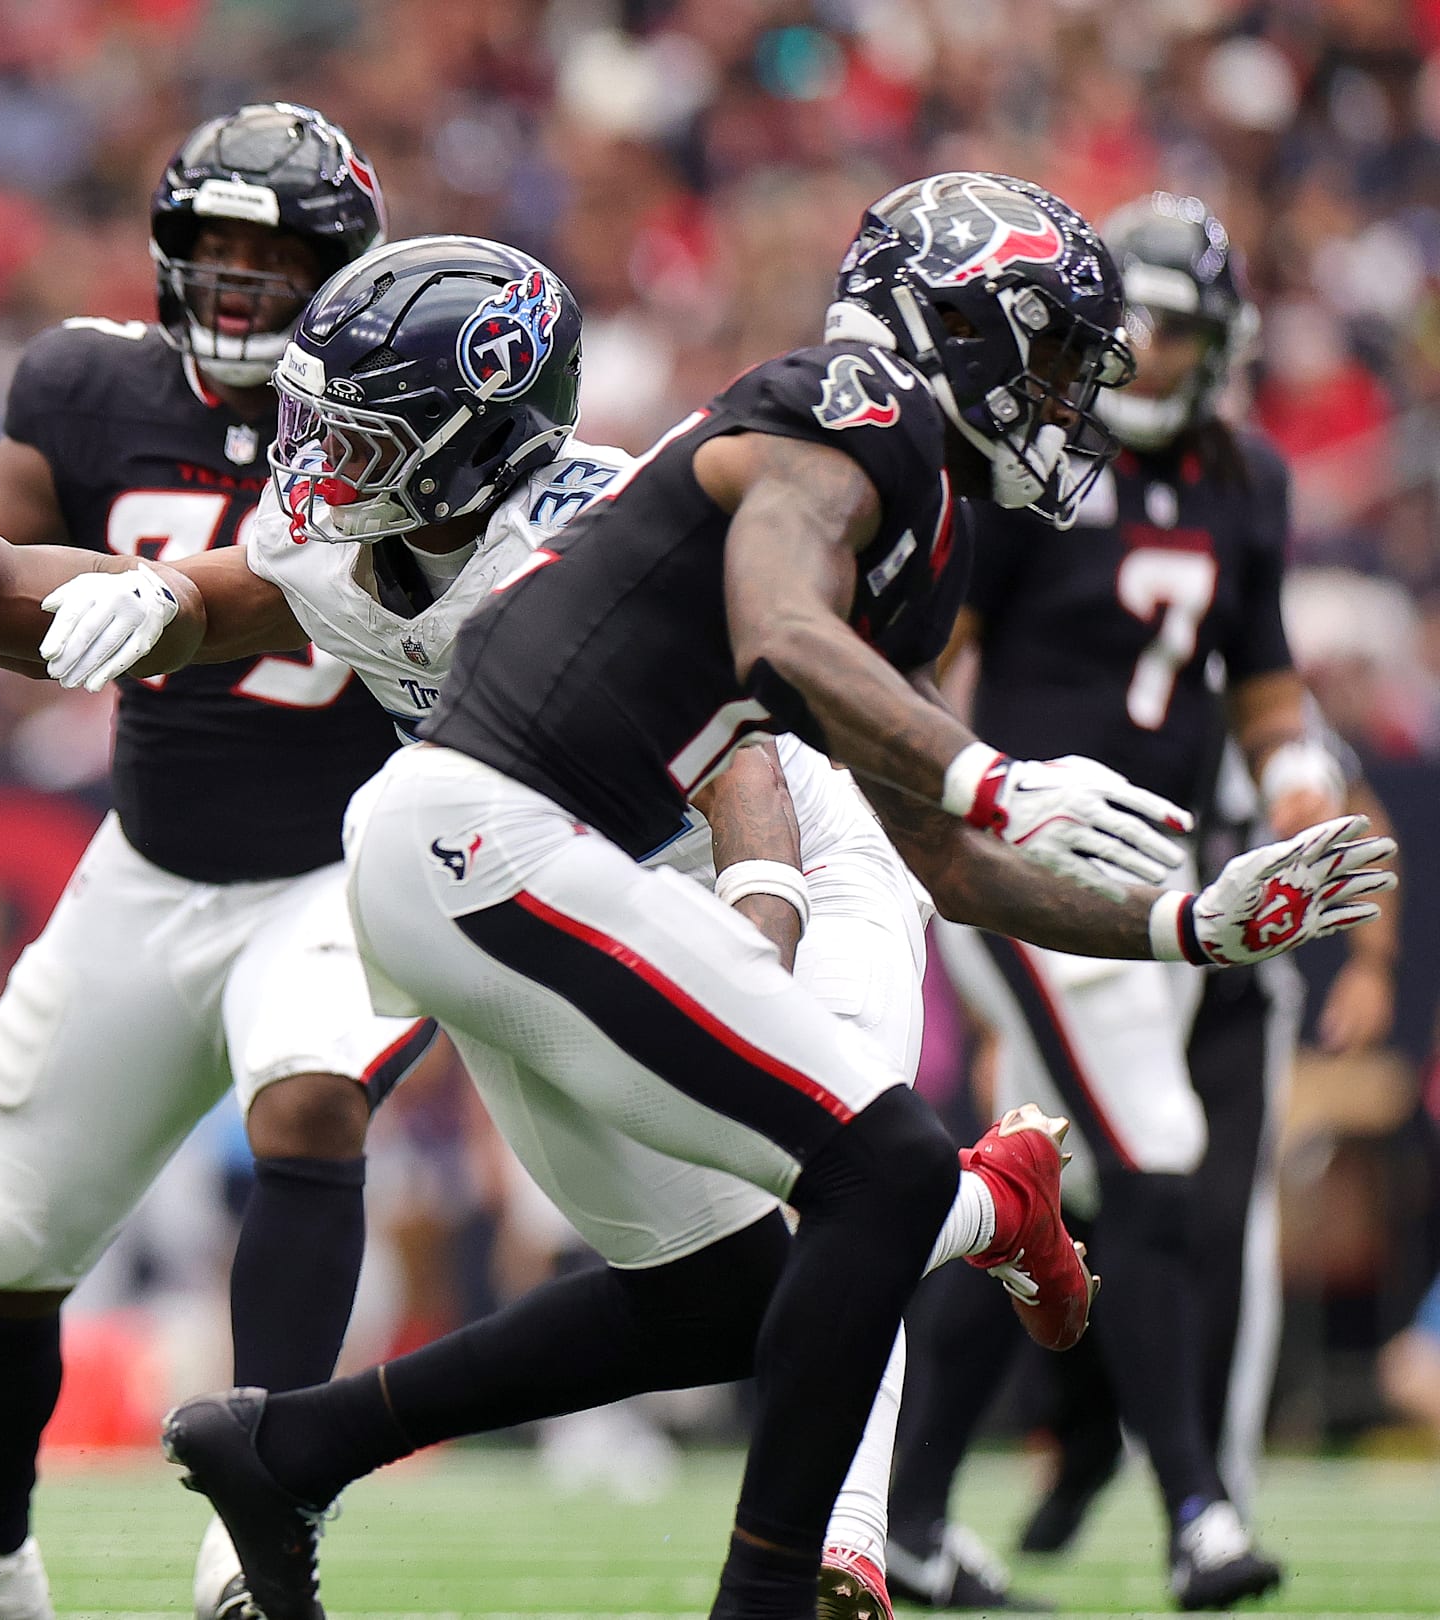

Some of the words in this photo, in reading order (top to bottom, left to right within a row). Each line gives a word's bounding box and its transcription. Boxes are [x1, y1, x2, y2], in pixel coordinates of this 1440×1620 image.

[326, 386, 364, 403] OAKLEY
[528, 458, 623, 529] 33
[1116, 544, 1220, 732] 7
